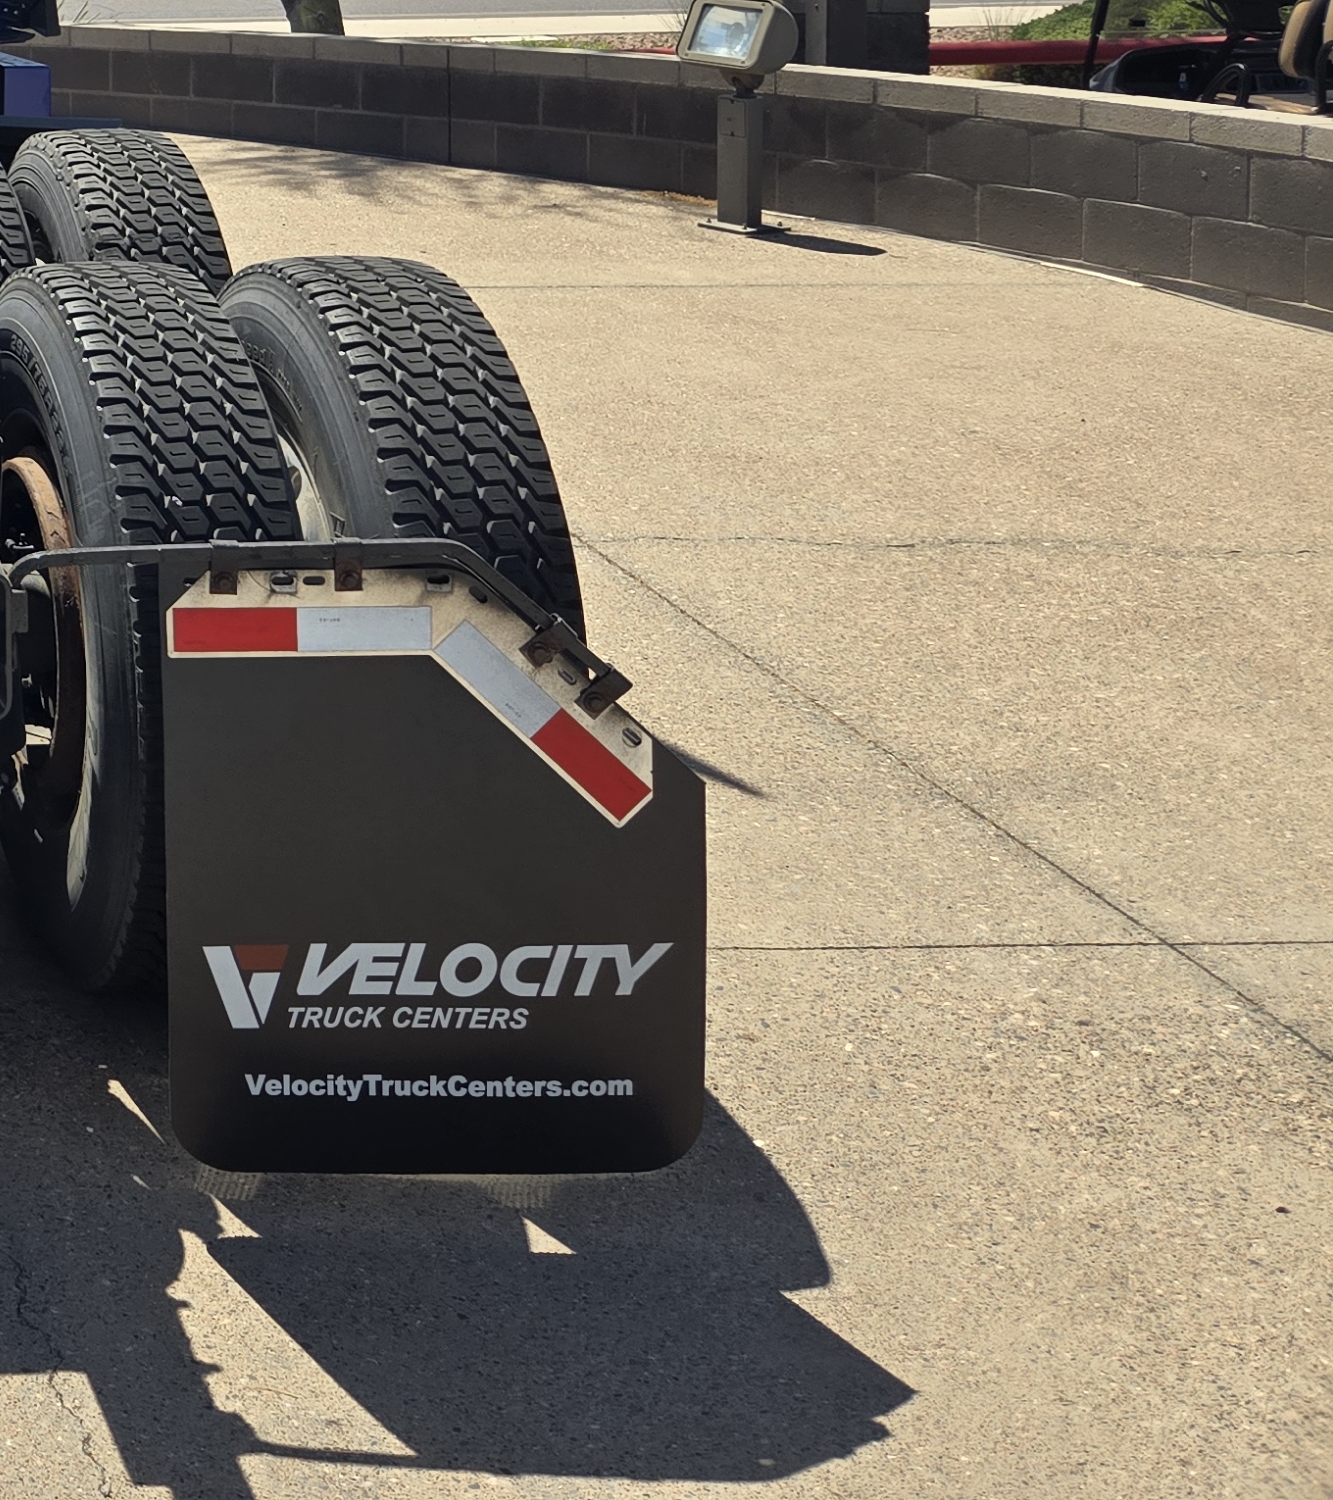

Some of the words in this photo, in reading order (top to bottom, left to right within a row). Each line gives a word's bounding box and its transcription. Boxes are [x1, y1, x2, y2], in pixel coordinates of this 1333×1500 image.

[296, 942, 675, 997] VELOCITY
[287, 1006, 383, 1029] TRUCK
[392, 1006, 529, 1030] CENTERS
[244, 1073, 634, 1102] VelocityTruckCenters.com
